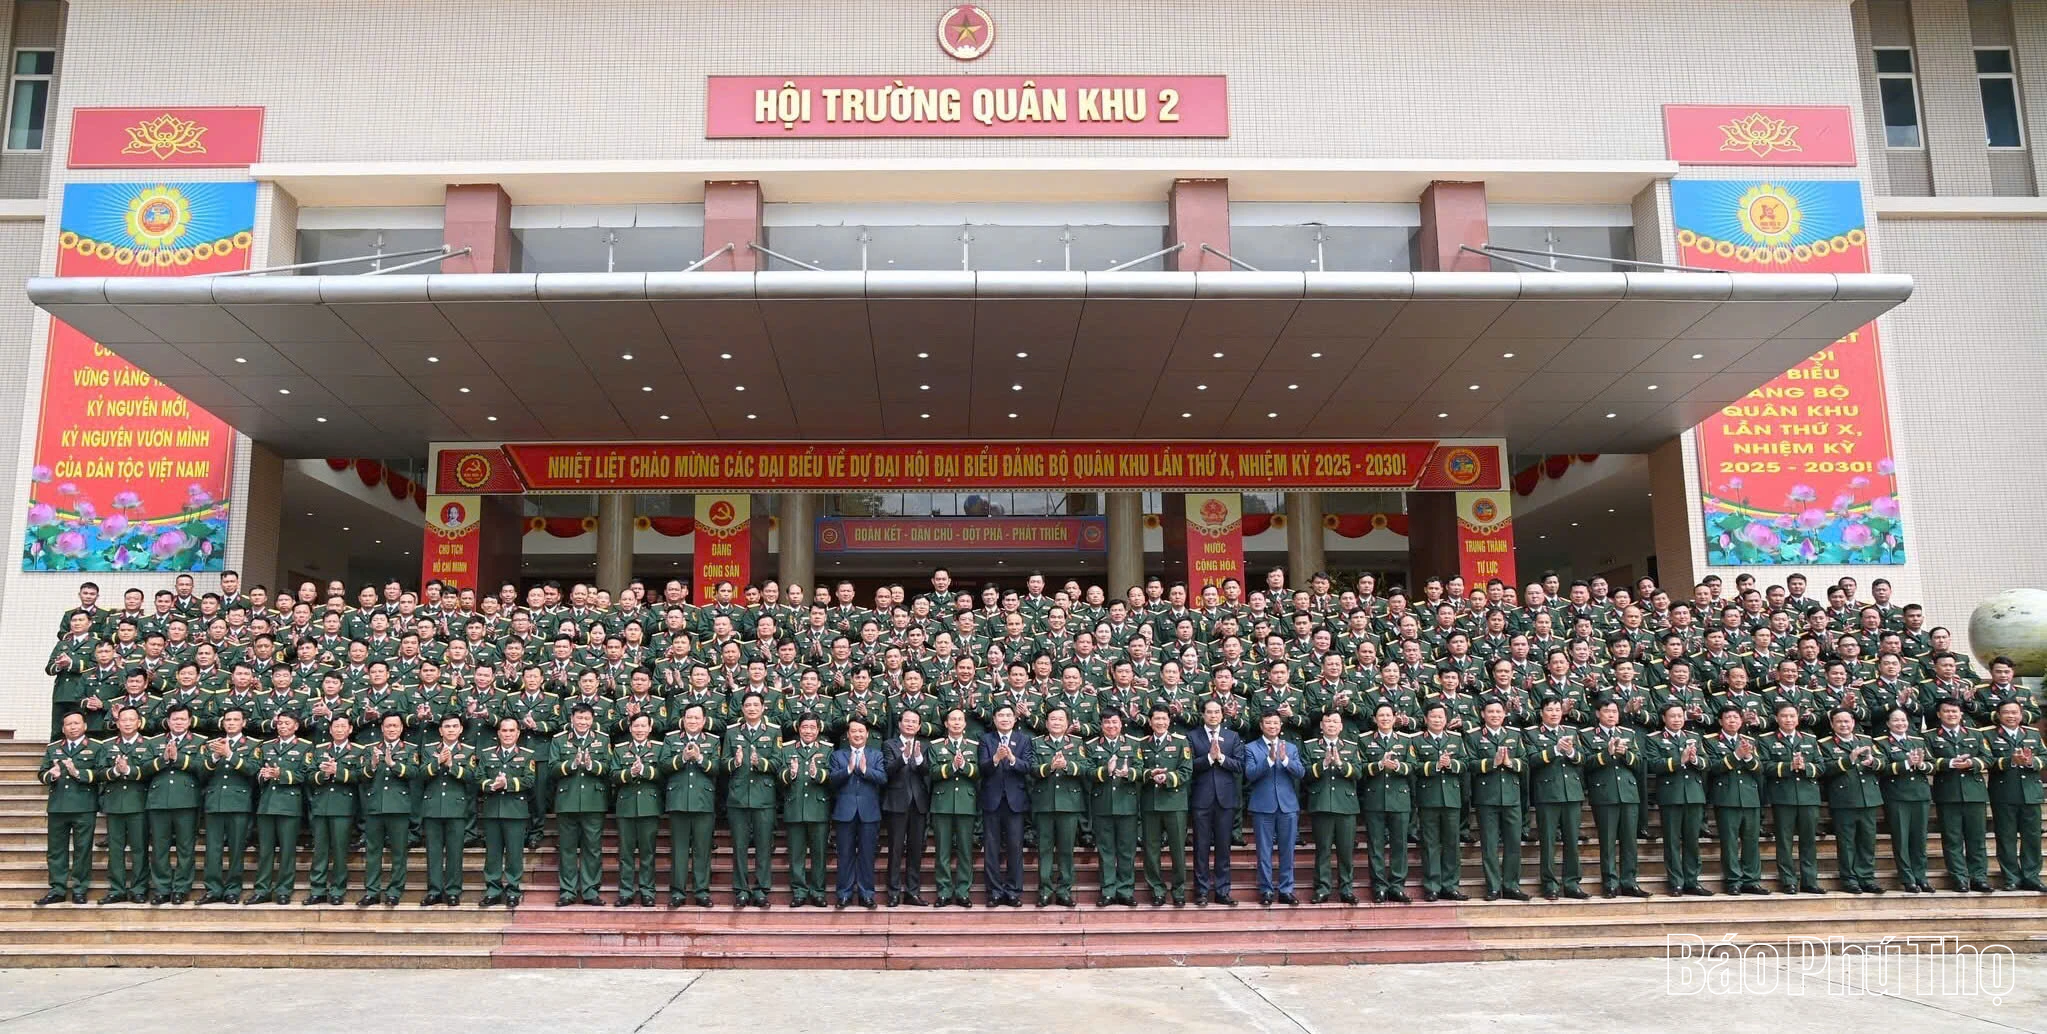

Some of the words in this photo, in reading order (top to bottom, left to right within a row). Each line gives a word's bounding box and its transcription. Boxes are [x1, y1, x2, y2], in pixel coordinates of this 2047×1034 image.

[755, 80, 811, 129] HỘI
[822, 80, 961, 123] TRƯỜNG
[972, 80, 1067, 125] QUÂN
[1078, 88, 1147, 121] KHU
[1159, 88, 1180, 122] 2
[73, 366, 109, 386] VỮNG
[113, 365, 151, 386] VÀNG
[1787, 362, 1840, 380] BIỂU
[1813, 384, 1850, 400] BỘ
[107, 395, 157, 417] NGUYÊN
[161, 395, 190, 419] MỚI,
[1721, 403, 1798, 417] QUÂN
[1807, 405, 1859, 417] KHU
[82, 425, 132, 447] NGUYÊN
[137, 428, 172, 447] VƯƠN
[176, 425, 210, 447] MÌNH
[1722, 420, 1772, 436] LẦN
[1780, 422, 1829, 436] THỨ
[1837, 424, 1863, 437] X,
[1733, 440, 1814, 457] NHIỆM
[1823, 440, 1856, 454] KỲ
[55, 454, 83, 478] CỦA
[86, 457, 114, 478] DÂN
[118, 456, 144, 483] TỘC
[148, 456, 173, 483] VIỆT
[176, 461, 210, 478] NAM!
[548, 451, 592, 483] NHIỆT
[595, 451, 626, 483] LIỆT
[630, 450, 670, 478] CHÀO
[675, 450, 719, 478] MỪNG
[724, 450, 754, 478] CÁC
[758, 455, 784, 483] ĐẠI
[788, 446, 823, 477] BIỂU
[827, 447, 846, 477] VỀ
[850, 453, 872, 483] DỰ
[874, 455, 900, 483] ĐẠI
[904, 450, 929, 483] HỘI
[934, 454, 959, 483] ĐẠI
[964, 445, 998, 477] BIỂU
[1003, 447, 1044, 477] ĐẢNG
[1049, 449, 1069, 482] BỘ
[1073, 449, 1115, 480] QUÂN
[1120, 454, 1149, 476] KHU
[1153, 446, 1183, 476] LẦN
[1187, 448, 1217, 476] THỨ
[1220, 454, 1235, 479] X,
[1239, 450, 1288, 481] NHIỆM
[1292, 450, 1310, 476] KỲ
[1315, 454, 1351, 476] 2025
[1365, 454, 1407, 476] 2030!
[1720, 461, 1781, 473] 2025
[1804, 461, 1873, 473] 2030!
[703, 562, 723, 580] CỘNG
[724, 560, 740, 578] SẢN
[1195, 559, 1218, 573] CỘNG
